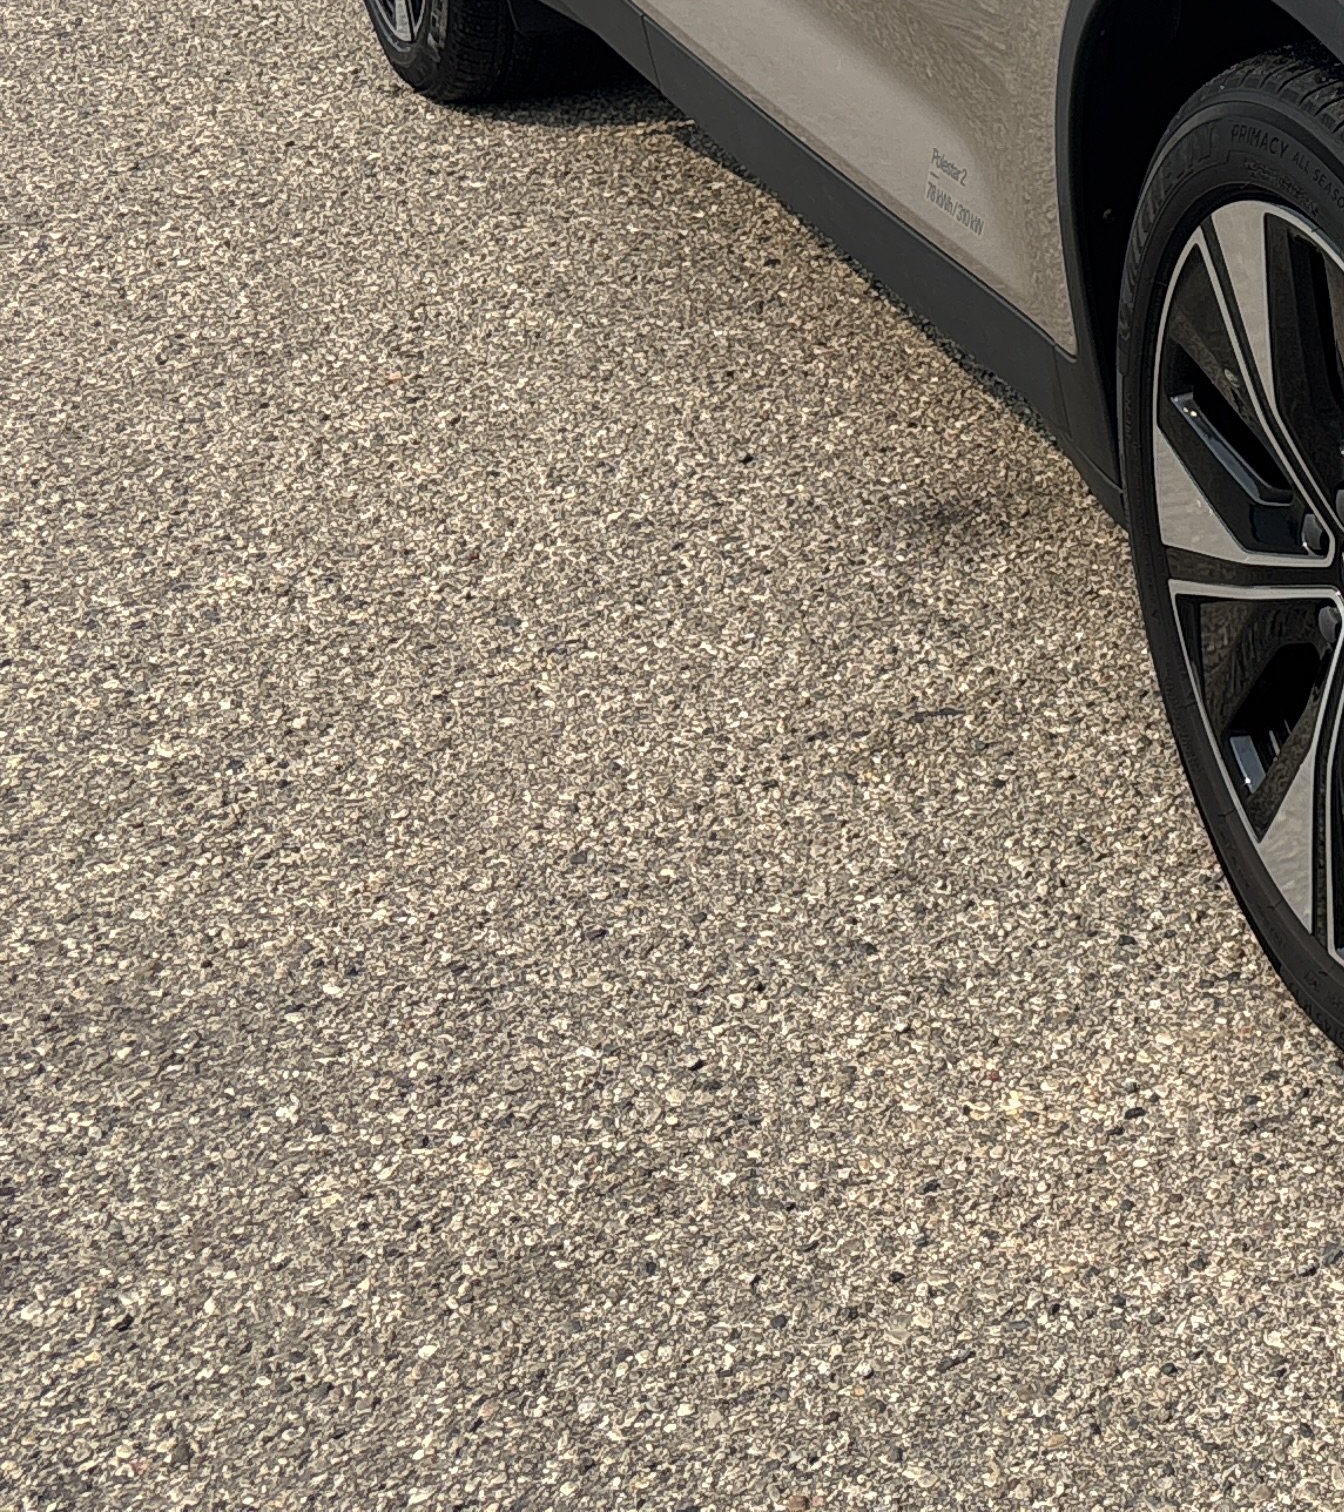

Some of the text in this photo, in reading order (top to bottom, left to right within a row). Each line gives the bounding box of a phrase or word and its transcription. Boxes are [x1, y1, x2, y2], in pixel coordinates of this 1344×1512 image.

[931, 147, 968, 187] Polestar 2
[1231, 124, 1289, 159] PRIMACY
[1293, 151, 1309, 175] ALL
